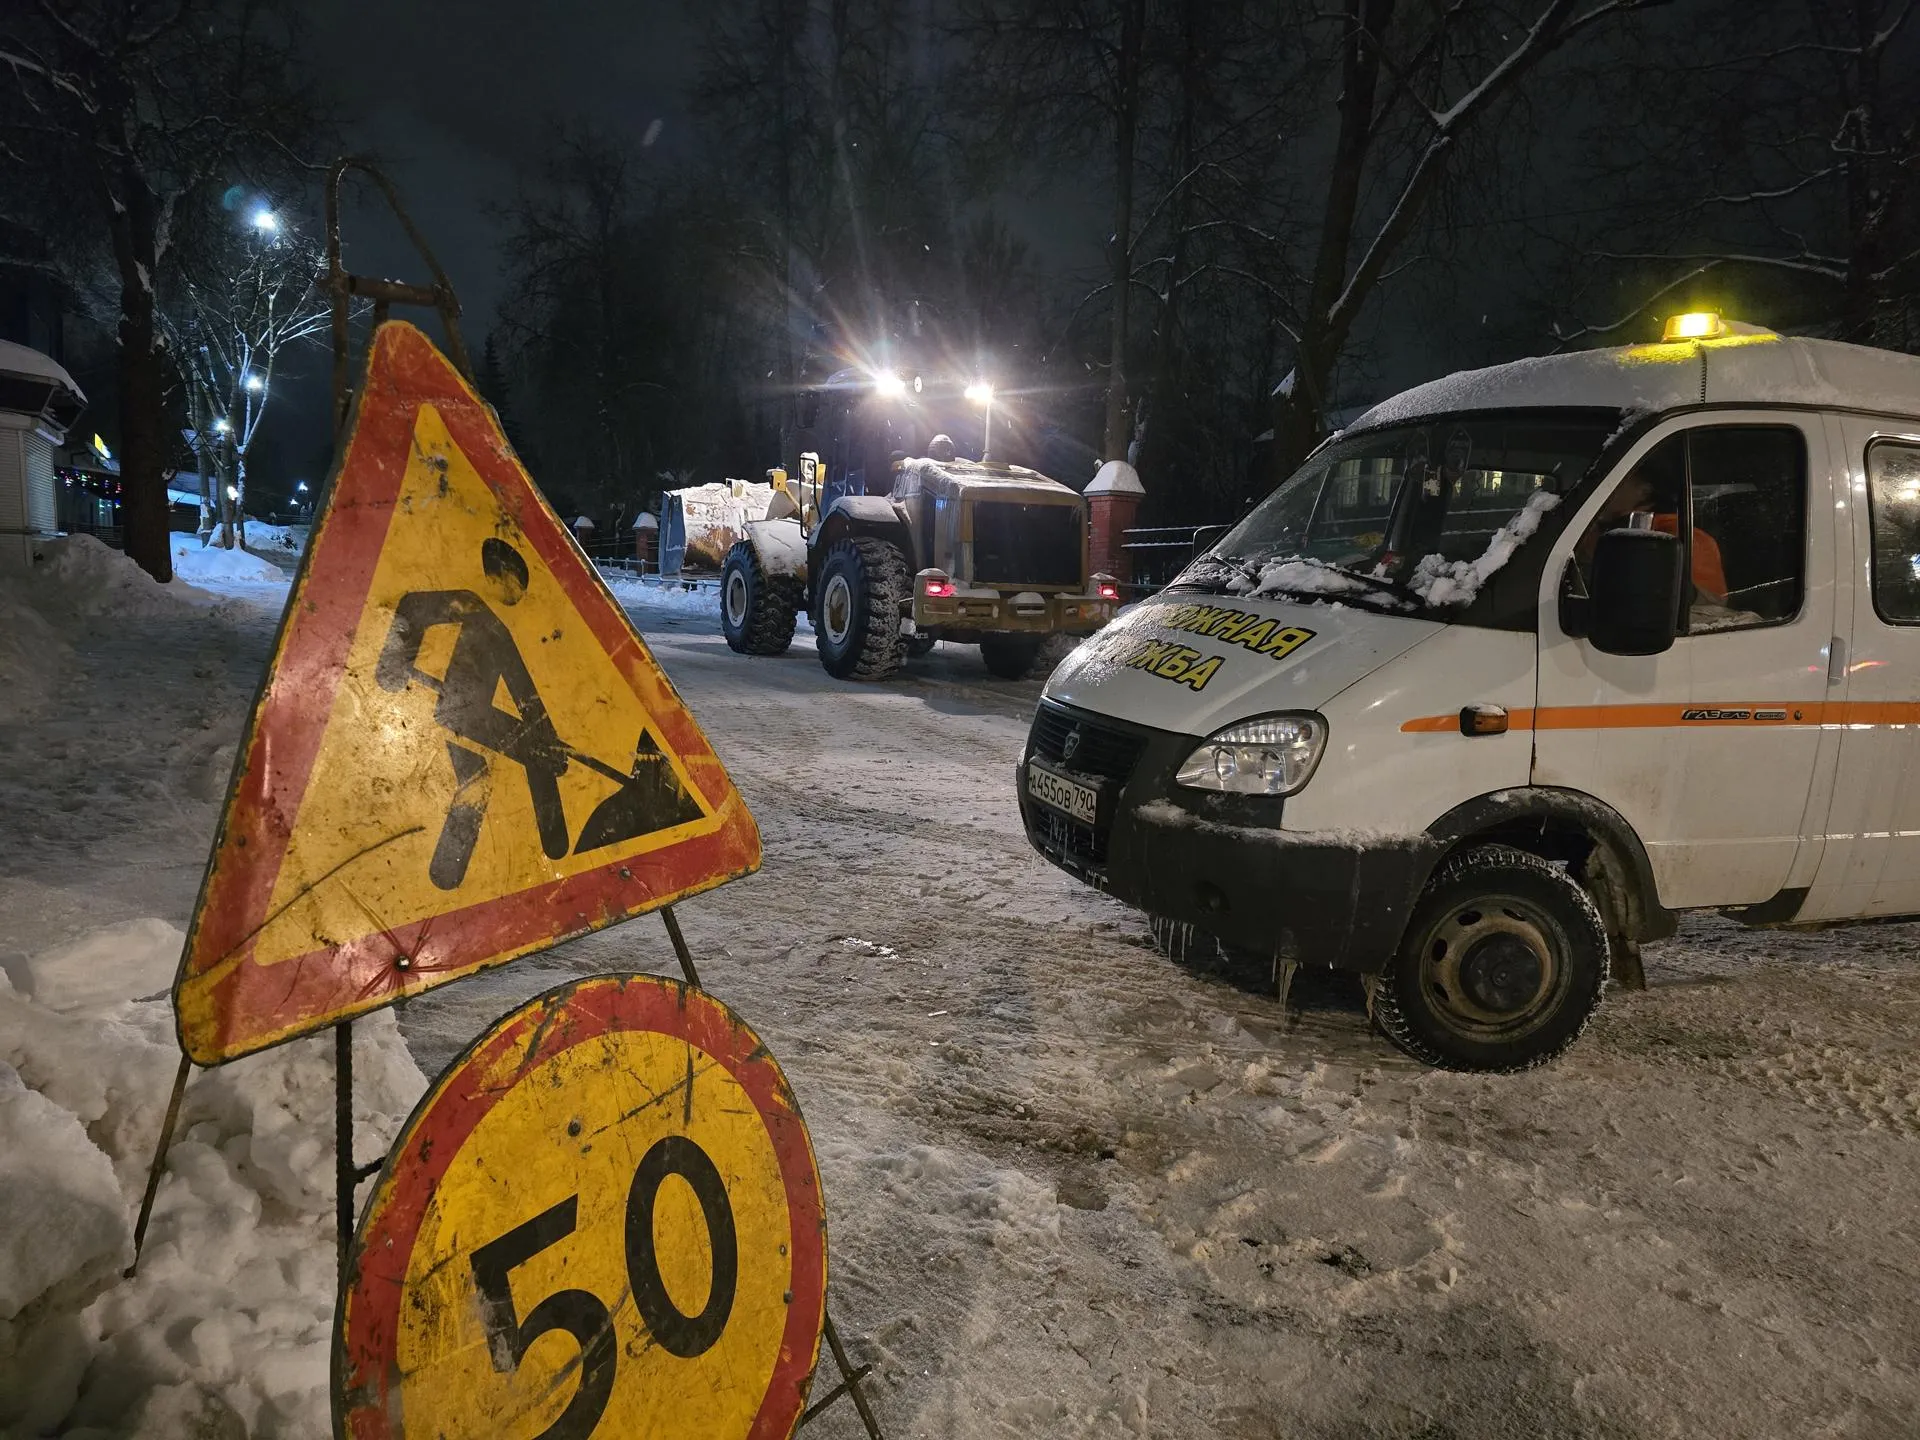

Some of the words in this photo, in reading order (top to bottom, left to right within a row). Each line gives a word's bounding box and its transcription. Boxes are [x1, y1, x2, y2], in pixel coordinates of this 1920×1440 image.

[1162, 603, 1317, 660] ОЖНАЯ
[1126, 639, 1225, 691] ЖБА
[1074, 786, 1093, 811] 790
[469, 1135, 738, 1440] 50
